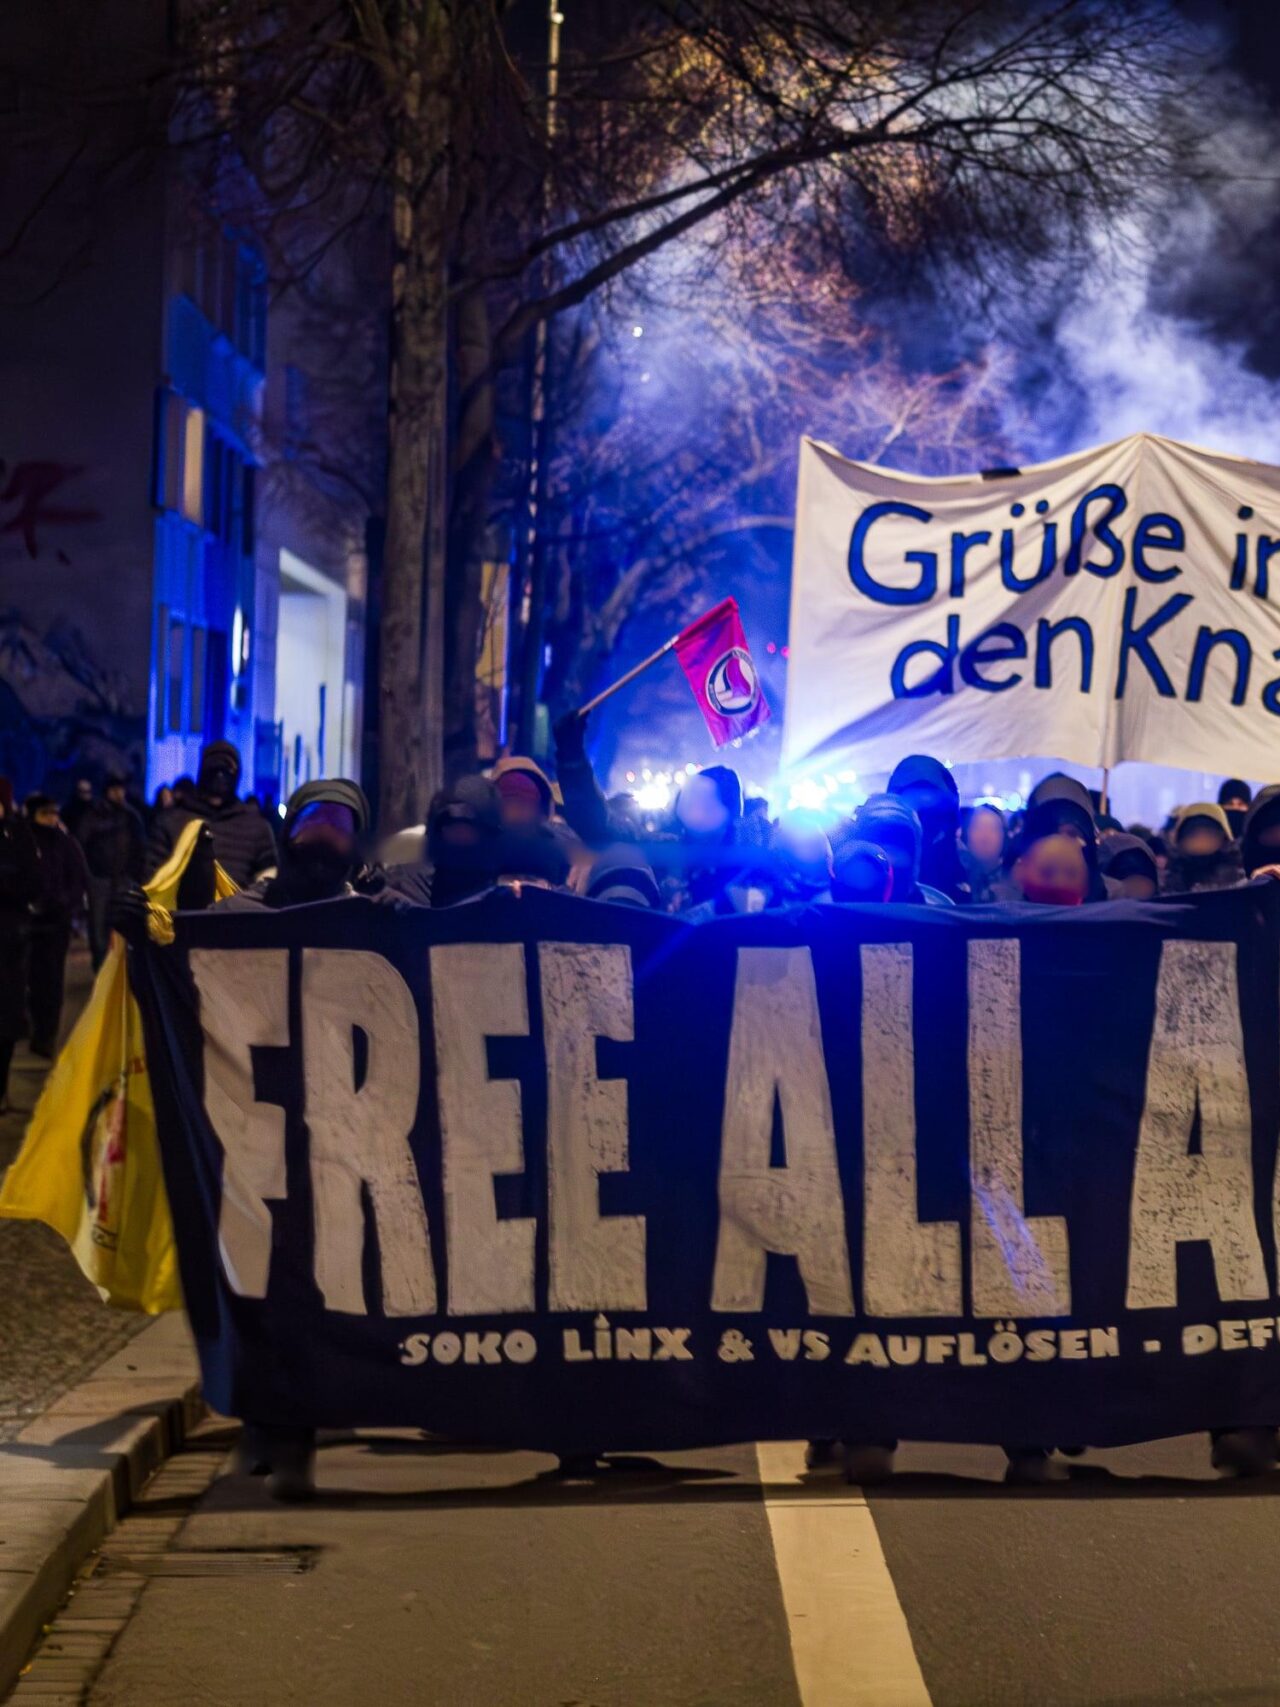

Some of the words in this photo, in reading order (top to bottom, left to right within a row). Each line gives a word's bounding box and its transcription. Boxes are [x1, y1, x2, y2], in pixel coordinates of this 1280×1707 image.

[847, 483, 1185, 606] Grüße
[890, 614, 1094, 700] den
[189, 941, 648, 1316] FREE
[710, 938, 1071, 1317] ALL
[399, 1330, 537, 1366] SOKO
[717, 1329, 755, 1363] &
[768, 1328, 831, 1362] VS
[845, 1320, 1120, 1368] AUFLÖSEN
